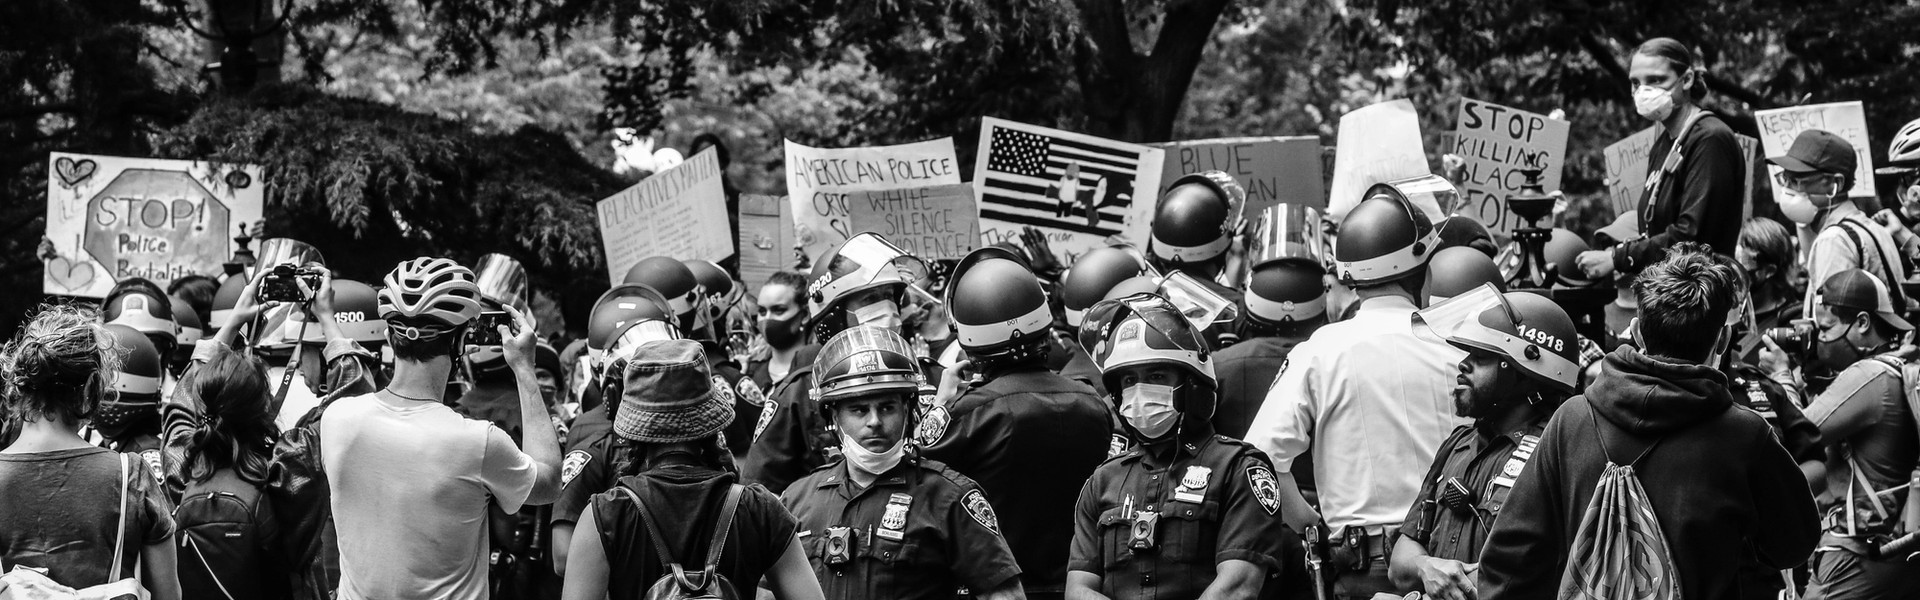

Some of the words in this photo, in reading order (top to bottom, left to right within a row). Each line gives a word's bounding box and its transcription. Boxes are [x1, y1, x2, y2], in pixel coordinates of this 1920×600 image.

[1464, 102, 1544, 143] STOP
[1760, 108, 1827, 135] RESPECT
[1180, 144, 1253, 175] BLUE
[1455, 133, 1551, 171] KILLING
[1606, 137, 1650, 177] United
[793, 155, 884, 189] AMERICAN
[888, 158, 952, 183] POLICE
[97, 196, 206, 232] STOP!
[602, 184, 648, 228] BLACK
[867, 188, 932, 212] WHITE
[885, 209, 956, 236] SILENCE
[118, 233, 167, 253] Police
[334, 311, 365, 324] 1500
[1517, 324, 1564, 352] 14918
